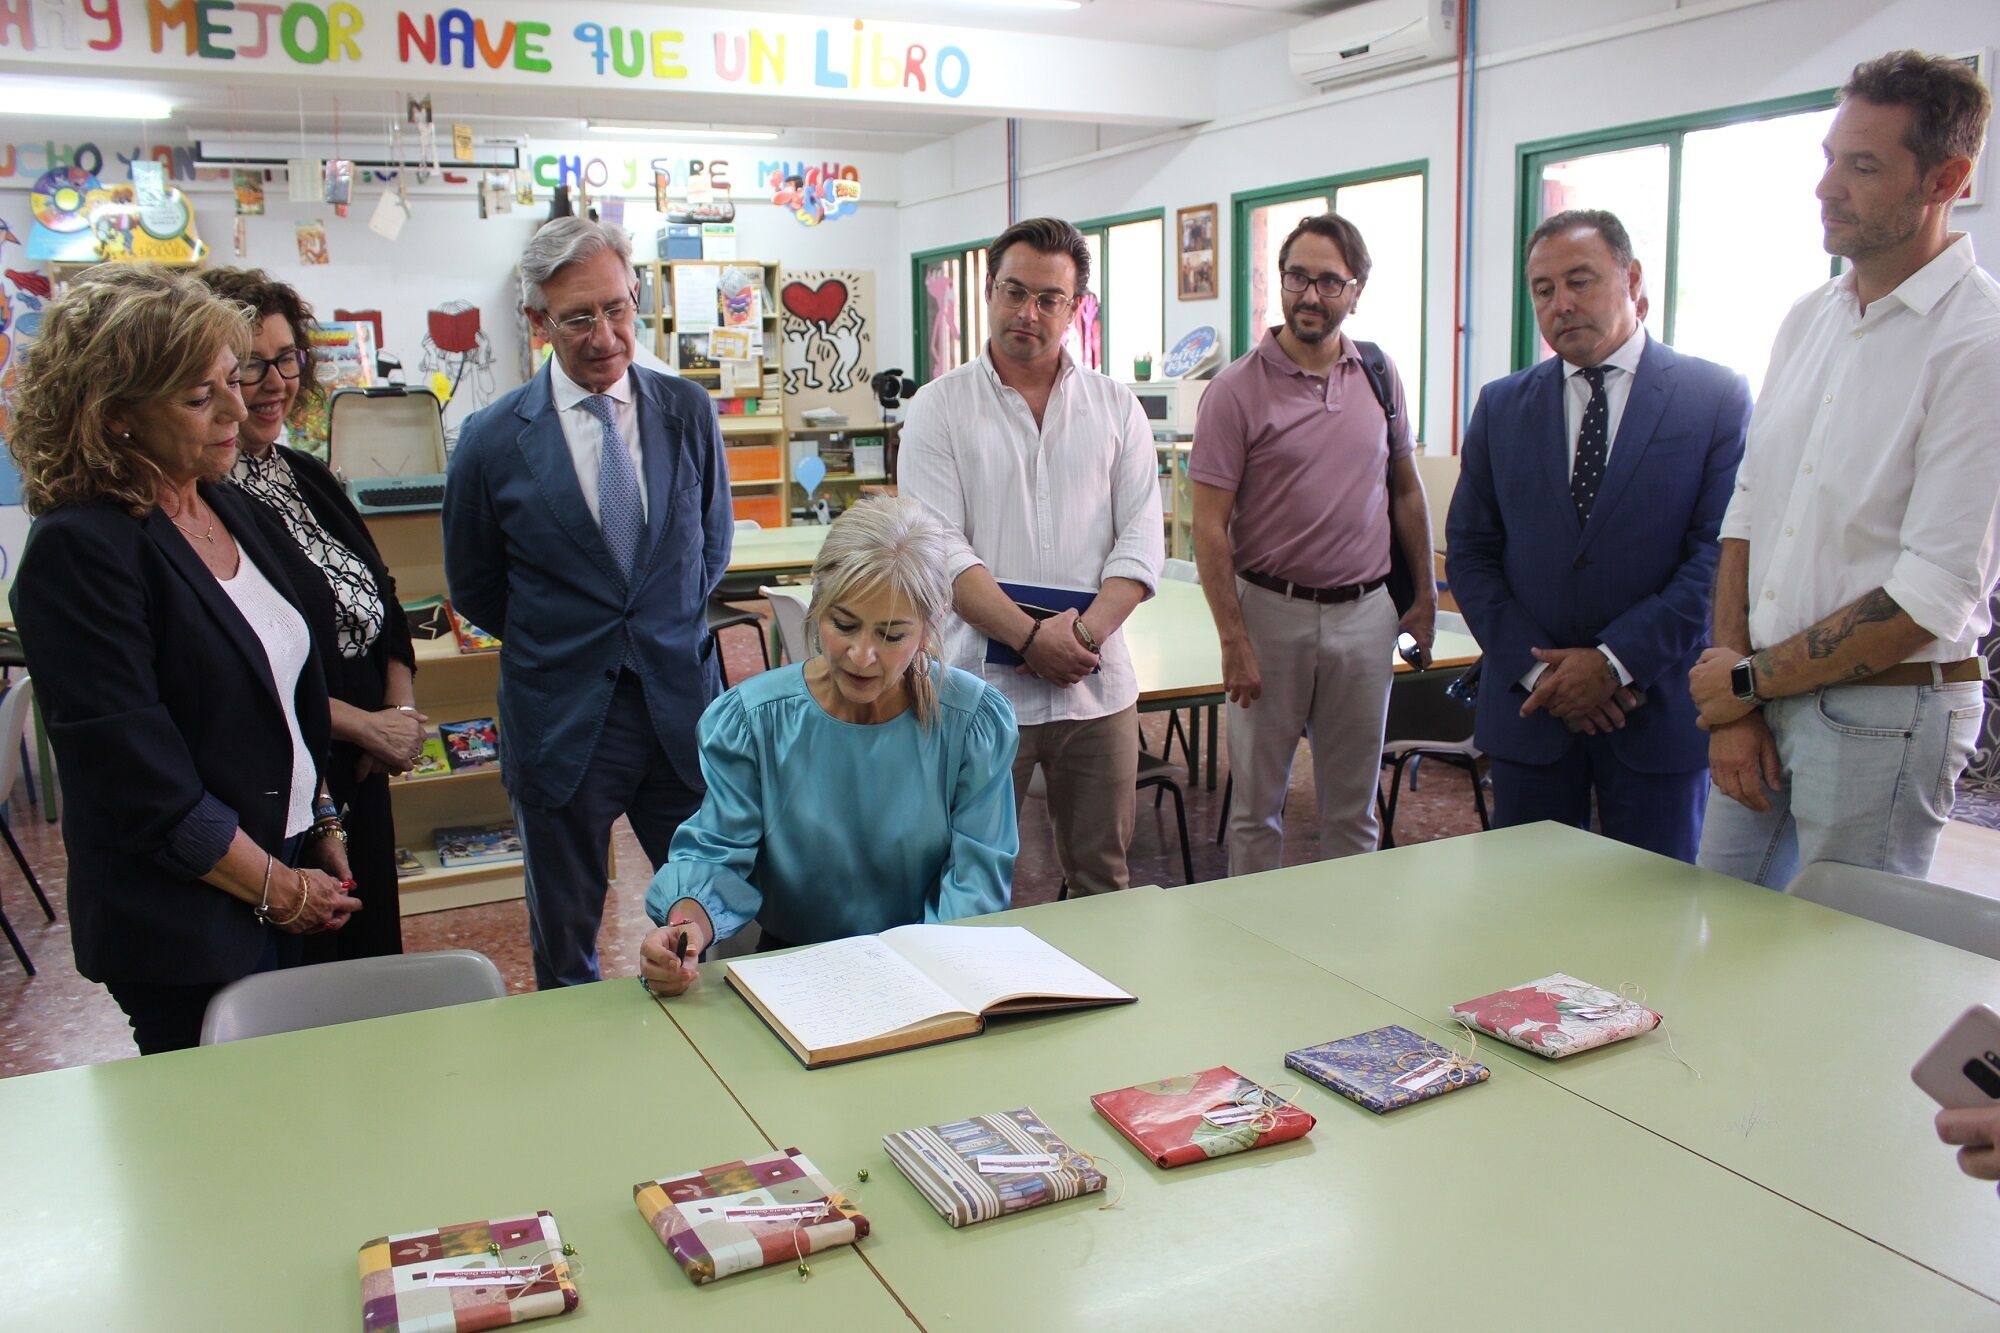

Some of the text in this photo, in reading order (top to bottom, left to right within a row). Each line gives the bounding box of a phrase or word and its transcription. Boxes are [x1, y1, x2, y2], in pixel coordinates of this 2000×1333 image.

[147, 0, 363, 62] MEJOR
[399, 8, 551, 73] NAVE
[714, 27, 785, 84] UN
